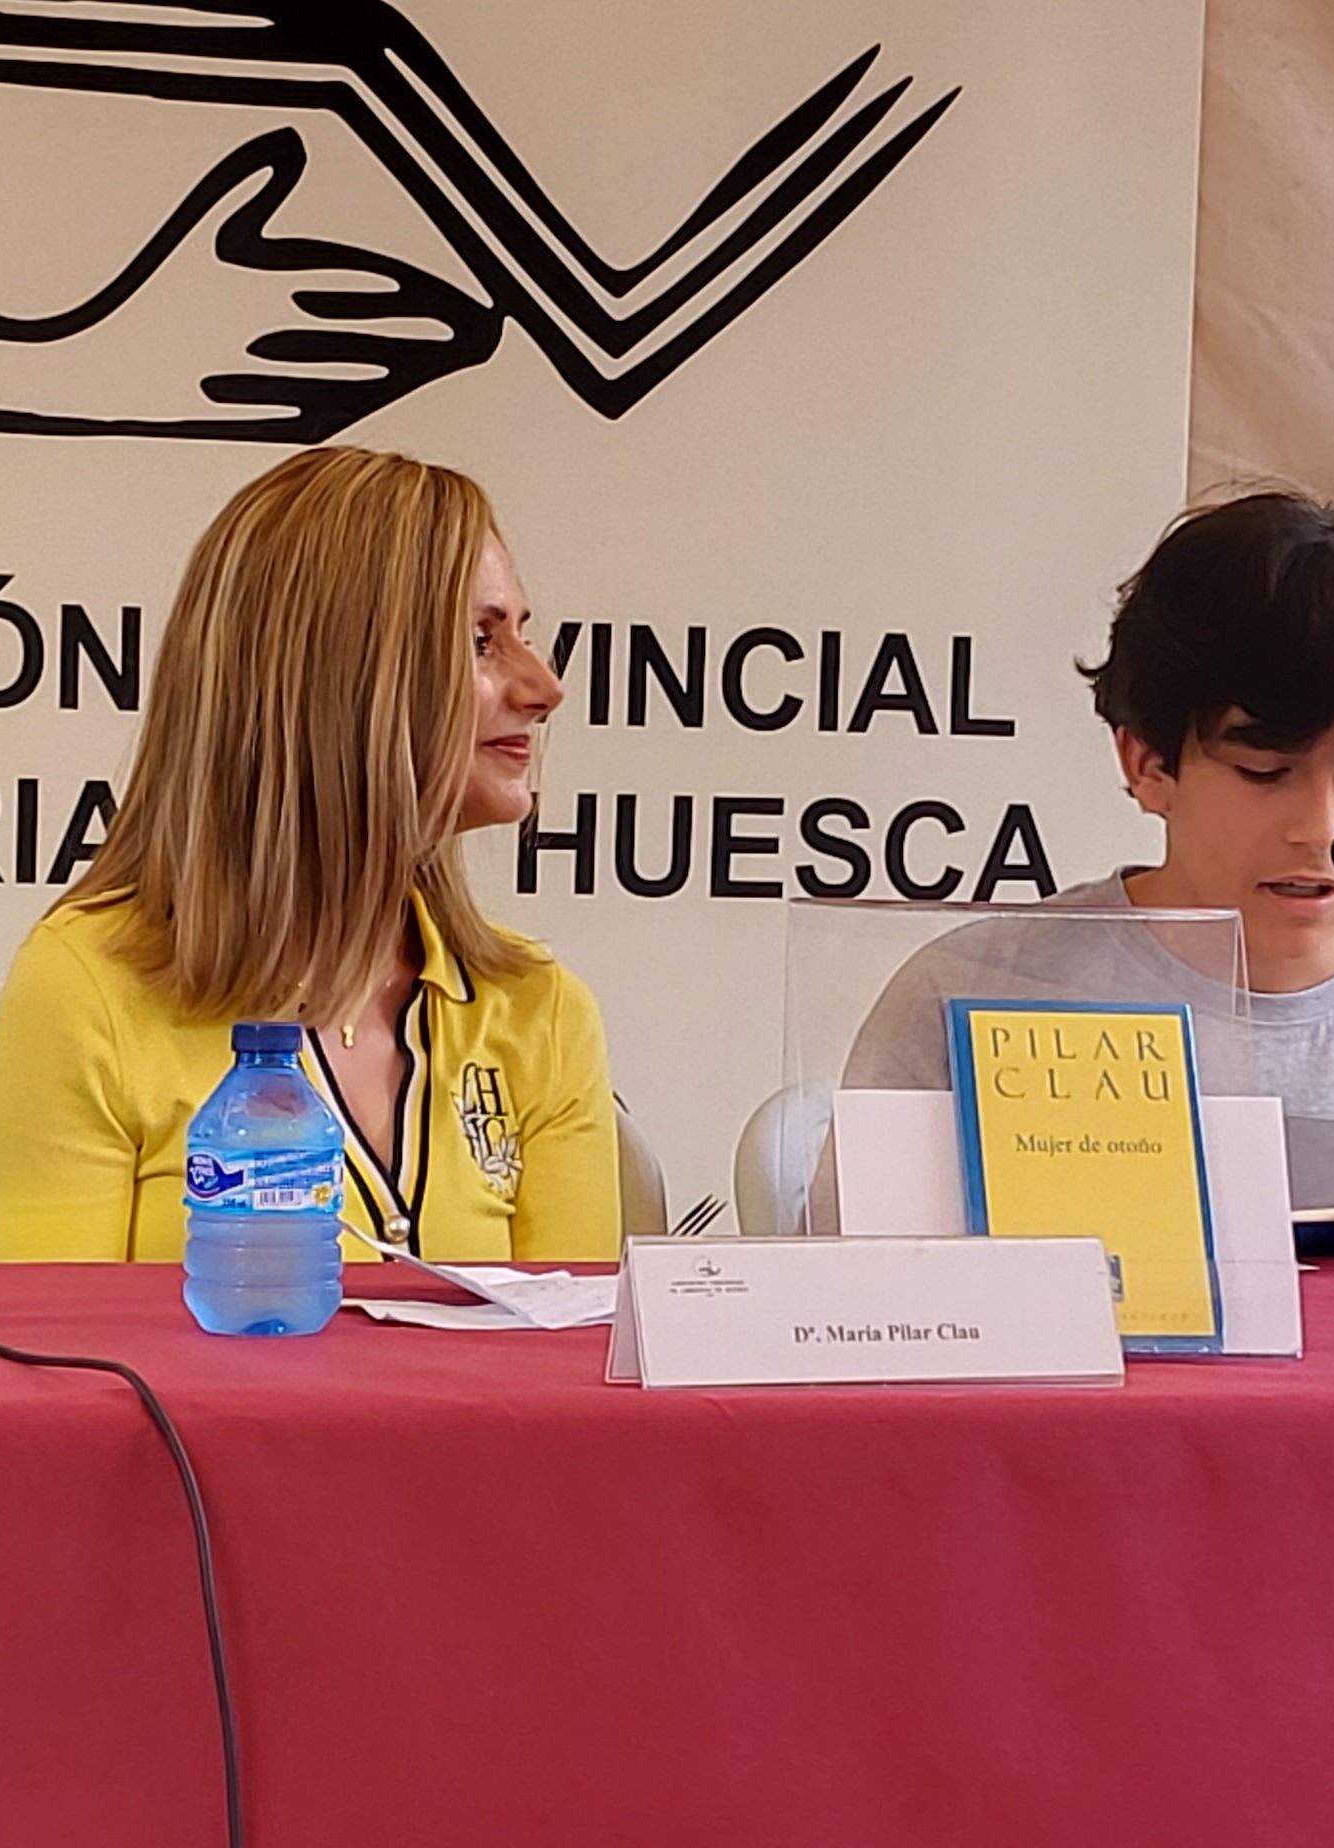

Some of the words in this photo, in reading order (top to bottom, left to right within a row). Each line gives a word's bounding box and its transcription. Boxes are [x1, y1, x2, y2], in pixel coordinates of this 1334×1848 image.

[516, 792, 1058, 903] HUESCA
[991, 1027, 1167, 1062] PILAR
[994, 1067, 1170, 1101] CLAU
[1015, 1133, 1073, 1157] Mujer
[1079, 1133, 1101, 1153] de
[888, 1323, 932, 1341] Pilar
[937, 1322, 980, 1340] Clau
